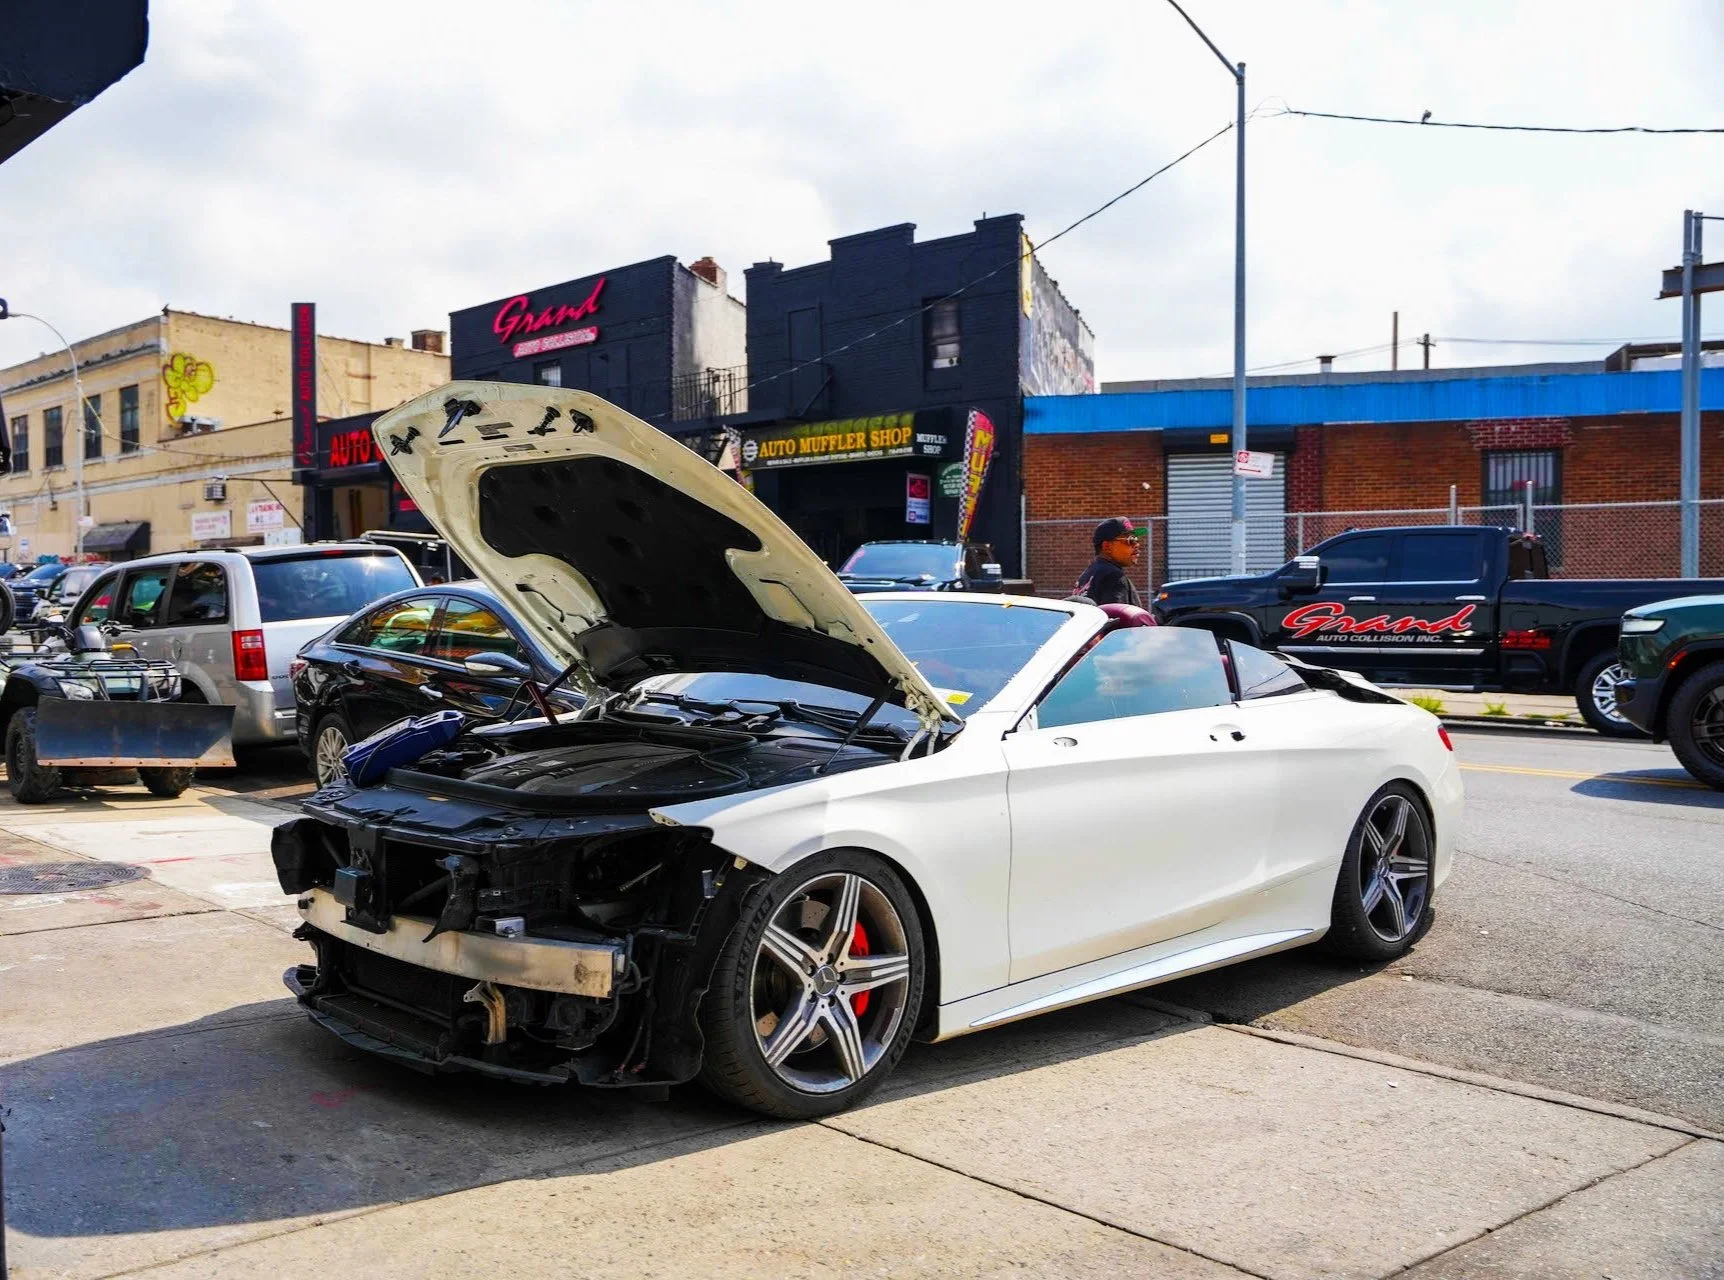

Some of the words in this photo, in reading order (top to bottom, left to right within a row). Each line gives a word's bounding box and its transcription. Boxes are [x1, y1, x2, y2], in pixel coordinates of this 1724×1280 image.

[493, 277, 606, 343] Grand
[329, 430, 371, 467] AUTO
[759, 439, 796, 458] AUTO
[799, 431, 867, 454] MUFFLER
[870, 426, 912, 448] SHOP
[923, 444, 942, 455] SHOP
[1282, 602, 1476, 638] Grand
[1316, 634, 1348, 642] AUTO
[1350, 634, 1414, 643] COLLISION
[1416, 634, 1443, 643] INC.
